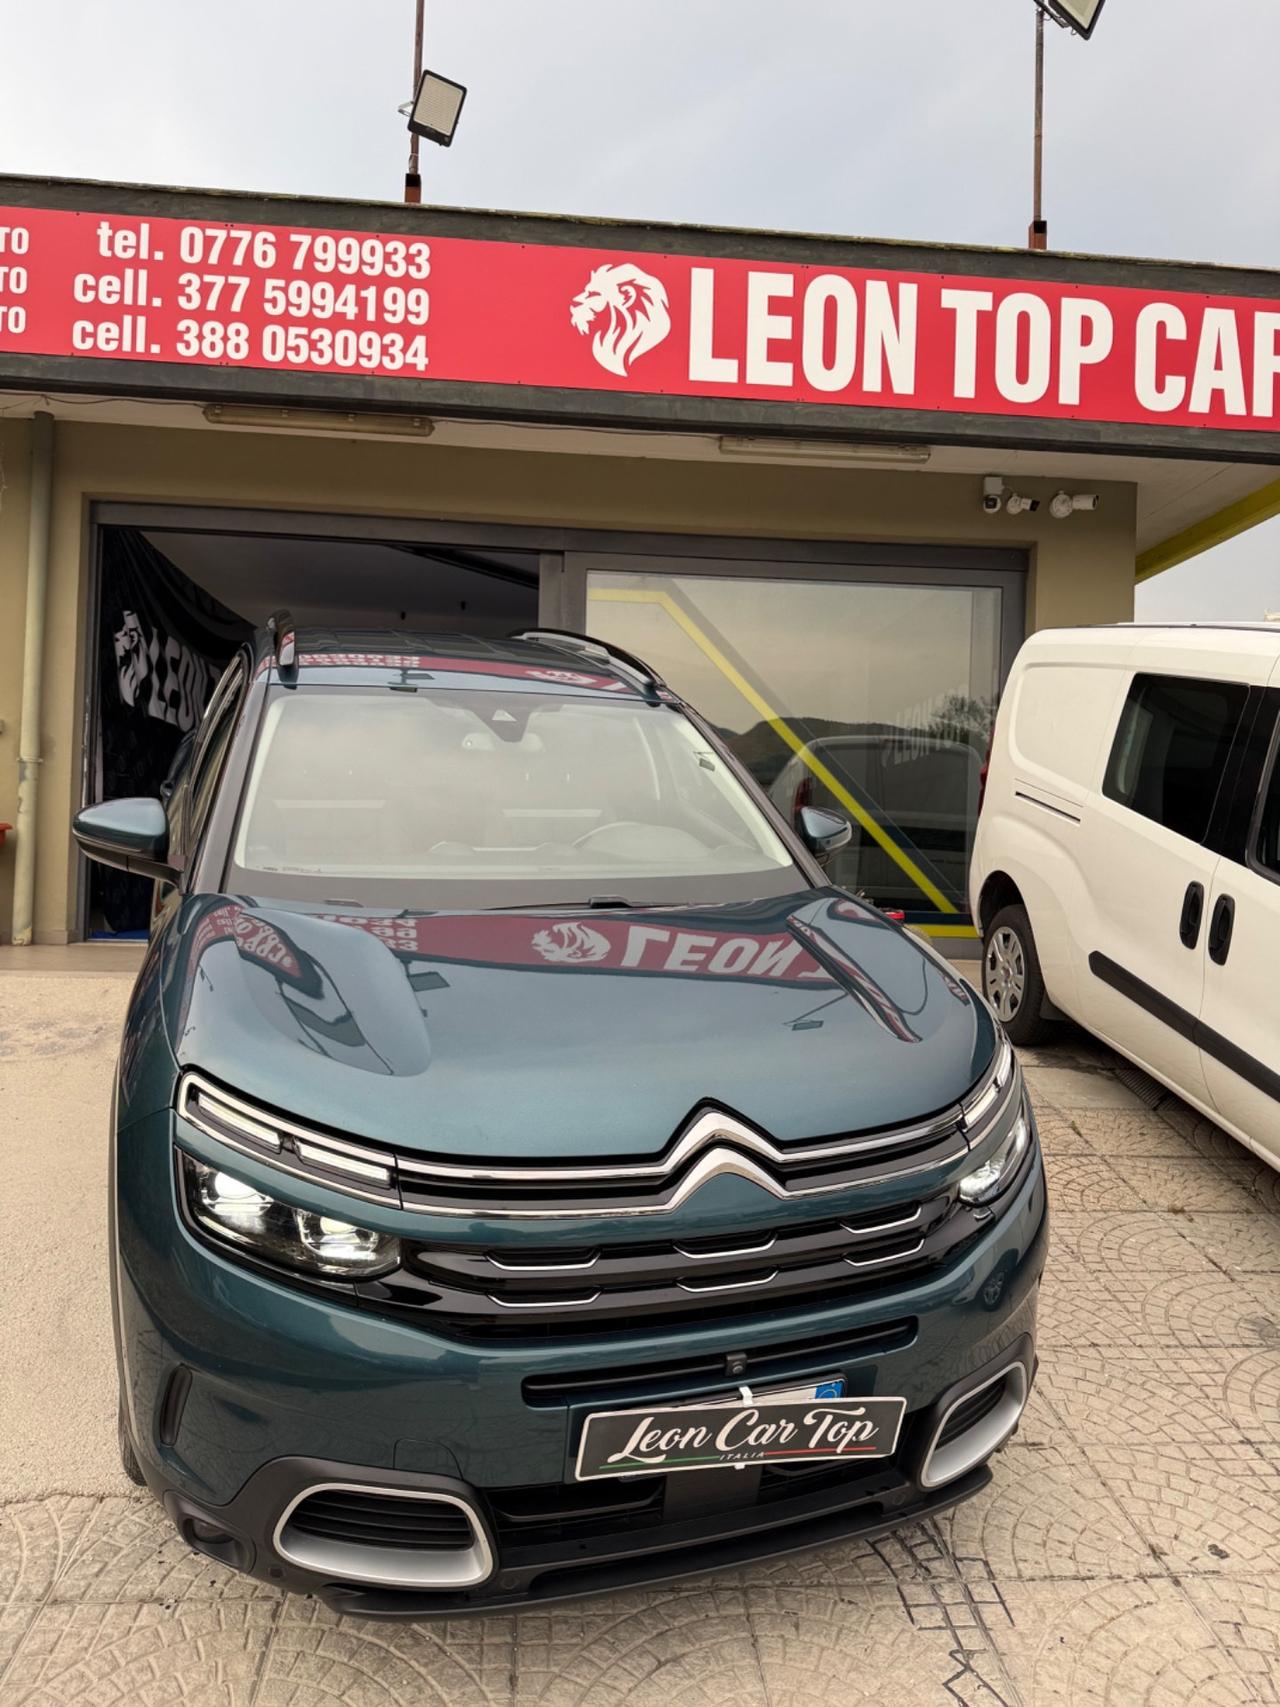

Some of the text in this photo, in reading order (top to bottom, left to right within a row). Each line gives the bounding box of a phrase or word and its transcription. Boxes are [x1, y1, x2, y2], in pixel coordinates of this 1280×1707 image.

[96, 221, 431, 280] tel. 0776 799933
[73, 268, 430, 326] cell. 377 5994199
[72, 314, 429, 371] cell. 388 0530934
[688, 267, 918, 395] LEON
[940, 288, 1114, 406] TOP
[607, 1406, 880, 1464] Leon Car Top
[720, 1452, 765, 1460] ITALIA
